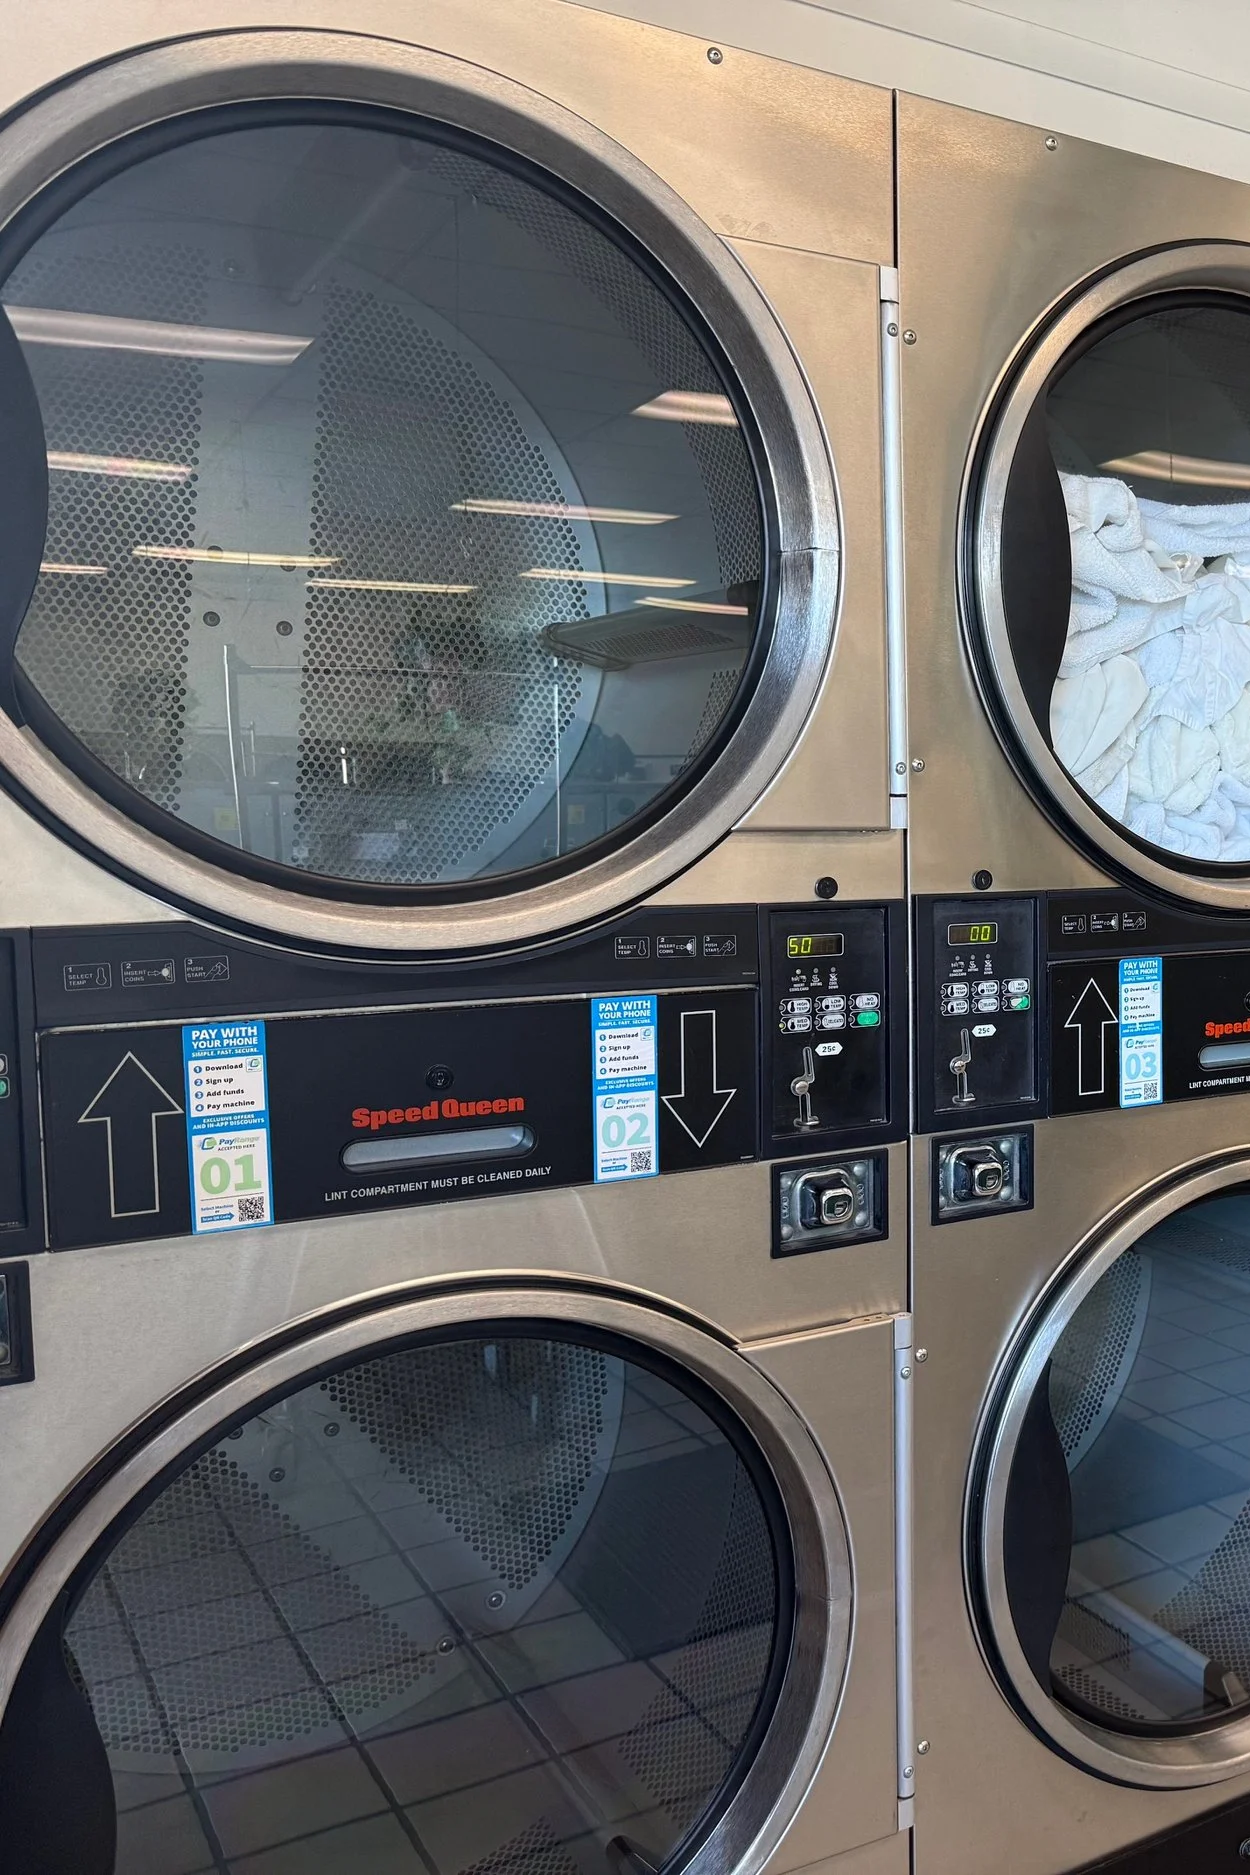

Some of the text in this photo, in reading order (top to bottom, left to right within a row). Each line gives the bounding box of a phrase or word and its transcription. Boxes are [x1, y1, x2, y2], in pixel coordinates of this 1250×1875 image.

[970, 925, 991, 941] 00
[789, 937, 812, 954] 50
[599, 1000, 651, 1012] PAY WITH
[623, 1010, 651, 1018] PHONE
[191, 1026, 258, 1041] PAY WITH
[191, 1037, 258, 1049] YOUR PHONE
[205, 1063, 243, 1072] Download
[1125, 1051, 1157, 1080] 03
[1189, 1081, 1202, 1089] LINT
[1202, 1076, 1245, 1087] COMPARTMENT
[223, 1088, 245, 1096] funds
[222, 1100, 256, 1108] machine
[203, 1115, 233, 1123] EXCLUSIVE
[352, 1096, 525, 1130] Speed Queen
[229, 1118, 265, 1127] DISCOUNTS
[602, 1112, 651, 1148] 02
[200, 1153, 262, 1195] 01
[325, 1165, 552, 1202] LINT COMPARTMENT MUST BE CLEANED DAILY
